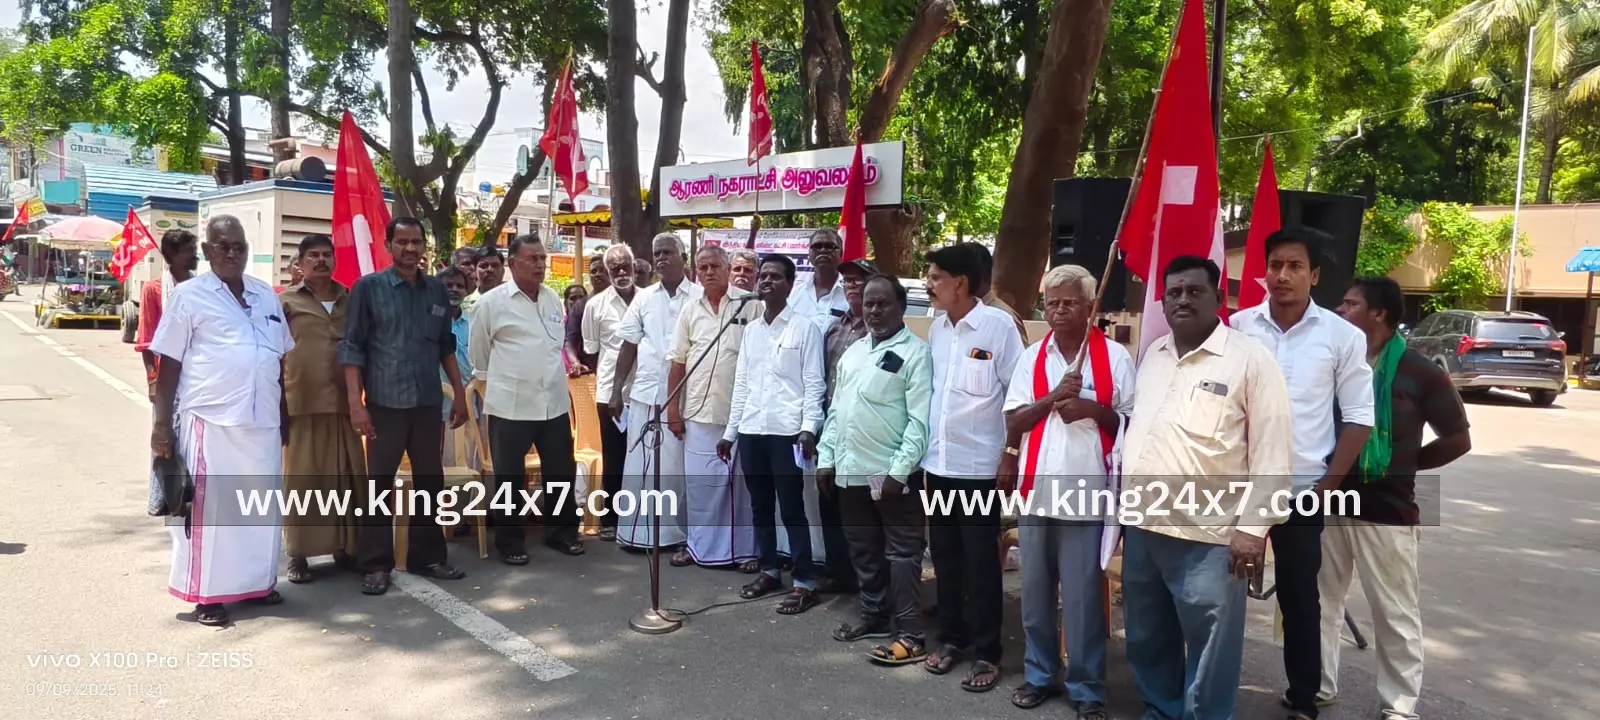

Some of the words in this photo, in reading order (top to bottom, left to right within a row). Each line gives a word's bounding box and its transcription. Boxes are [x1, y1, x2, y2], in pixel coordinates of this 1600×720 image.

[70, 143, 102, 154] GREEN
[669, 174, 714, 201] ஆரணி
[717, 167, 777, 201] நகராட்சி
[781, 158, 877, 196] அலுவலம்
